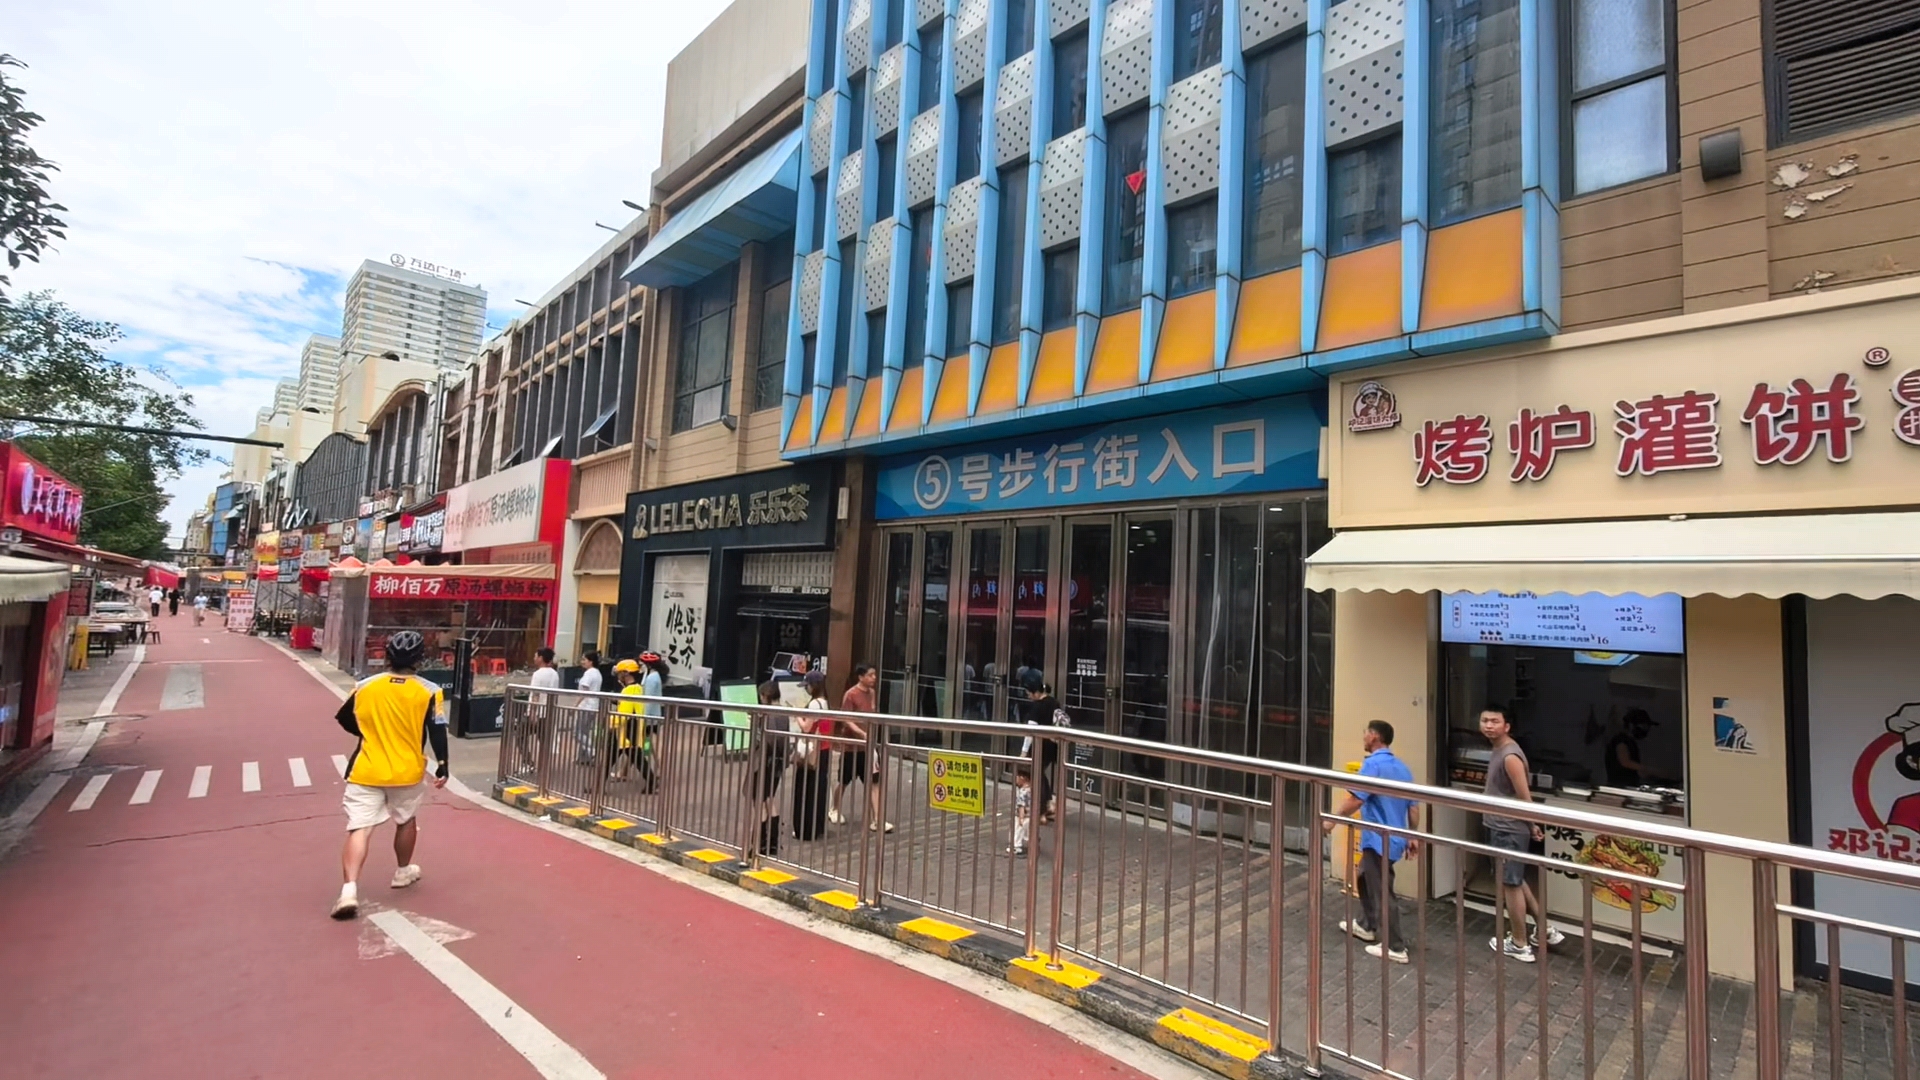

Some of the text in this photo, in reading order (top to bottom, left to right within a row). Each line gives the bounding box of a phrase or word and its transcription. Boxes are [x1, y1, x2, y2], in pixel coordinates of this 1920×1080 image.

[1413, 371, 1866, 488] 烤炉灌饼
[650, 493, 743, 535] LELECHA
[747, 482, 810, 525] 乐乐茶
[373, 575, 548, 598] 柳佰万原汤螺蛳粉
[1827, 827, 1920, 864] 邓记
